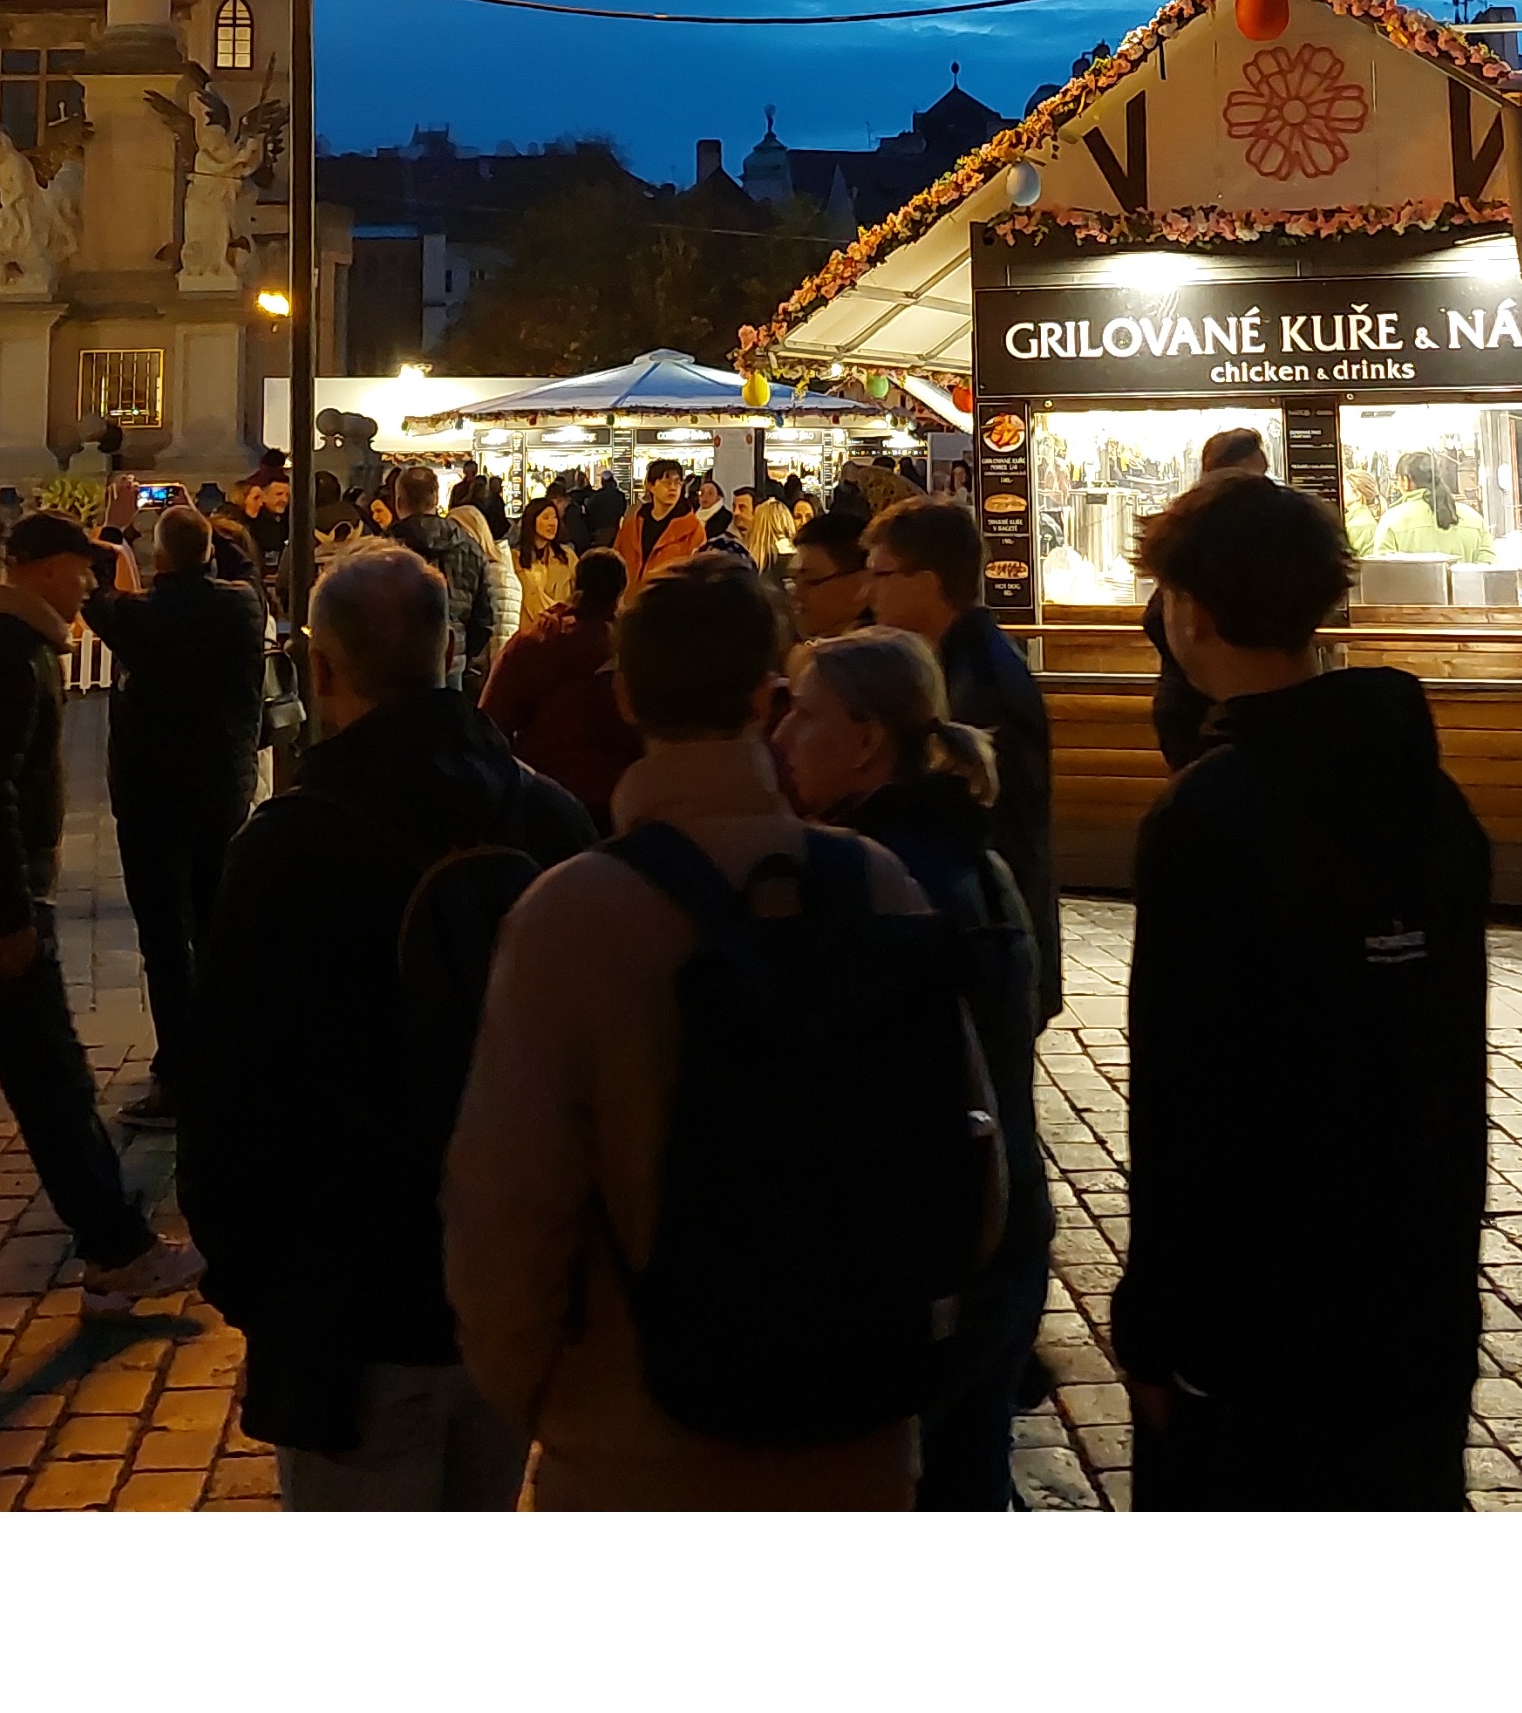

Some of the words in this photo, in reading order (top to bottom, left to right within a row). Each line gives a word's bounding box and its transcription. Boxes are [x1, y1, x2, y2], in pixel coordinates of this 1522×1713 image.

[1004, 306, 1267, 362] GRILOVANÉ
[1280, 302, 1405, 353] KUŘE
[1414, 326, 1442, 351] &
[1210, 360, 1310, 383] chicken
[1316, 367, 1331, 381] &
[1332, 358, 1417, 381] drinks
